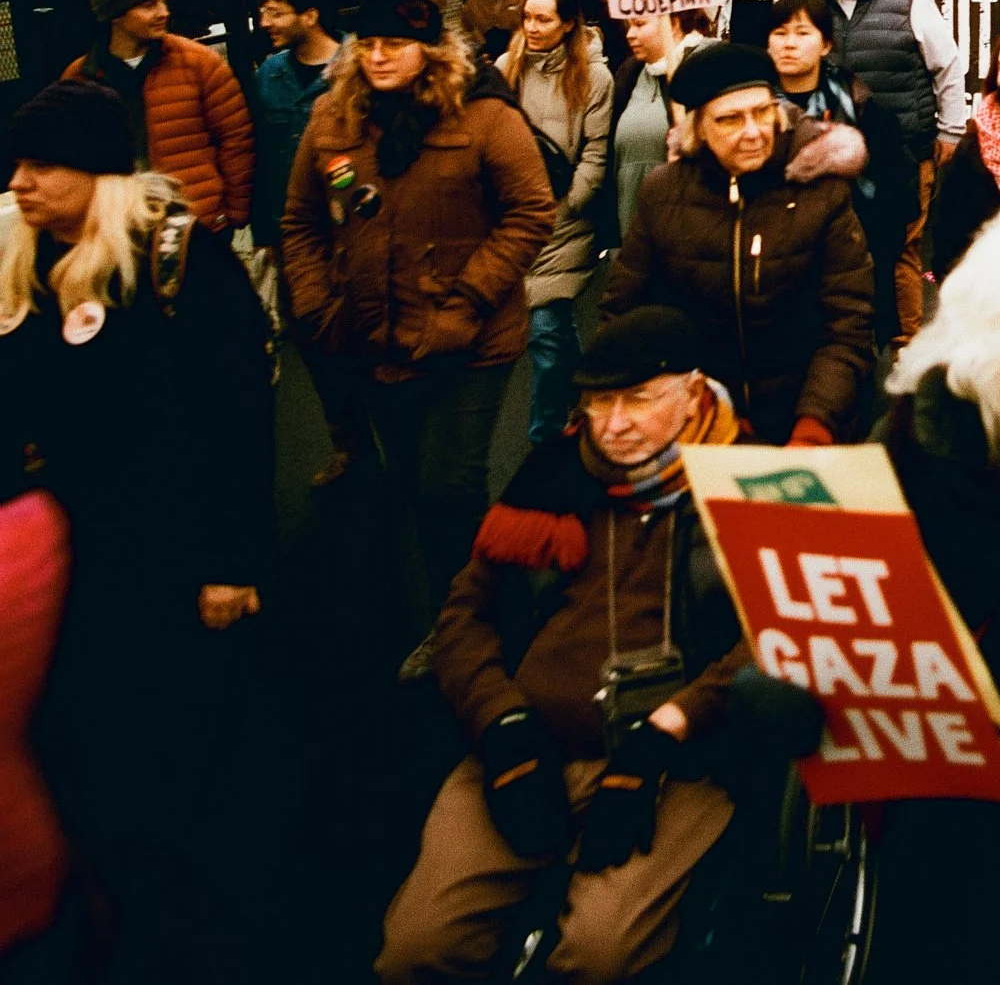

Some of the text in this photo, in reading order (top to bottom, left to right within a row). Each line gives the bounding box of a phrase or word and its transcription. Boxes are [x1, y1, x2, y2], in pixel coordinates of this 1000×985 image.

[758, 547, 894, 627] LET
[757, 627, 977, 703] GAZA
[821, 707, 987, 765] LIVE
